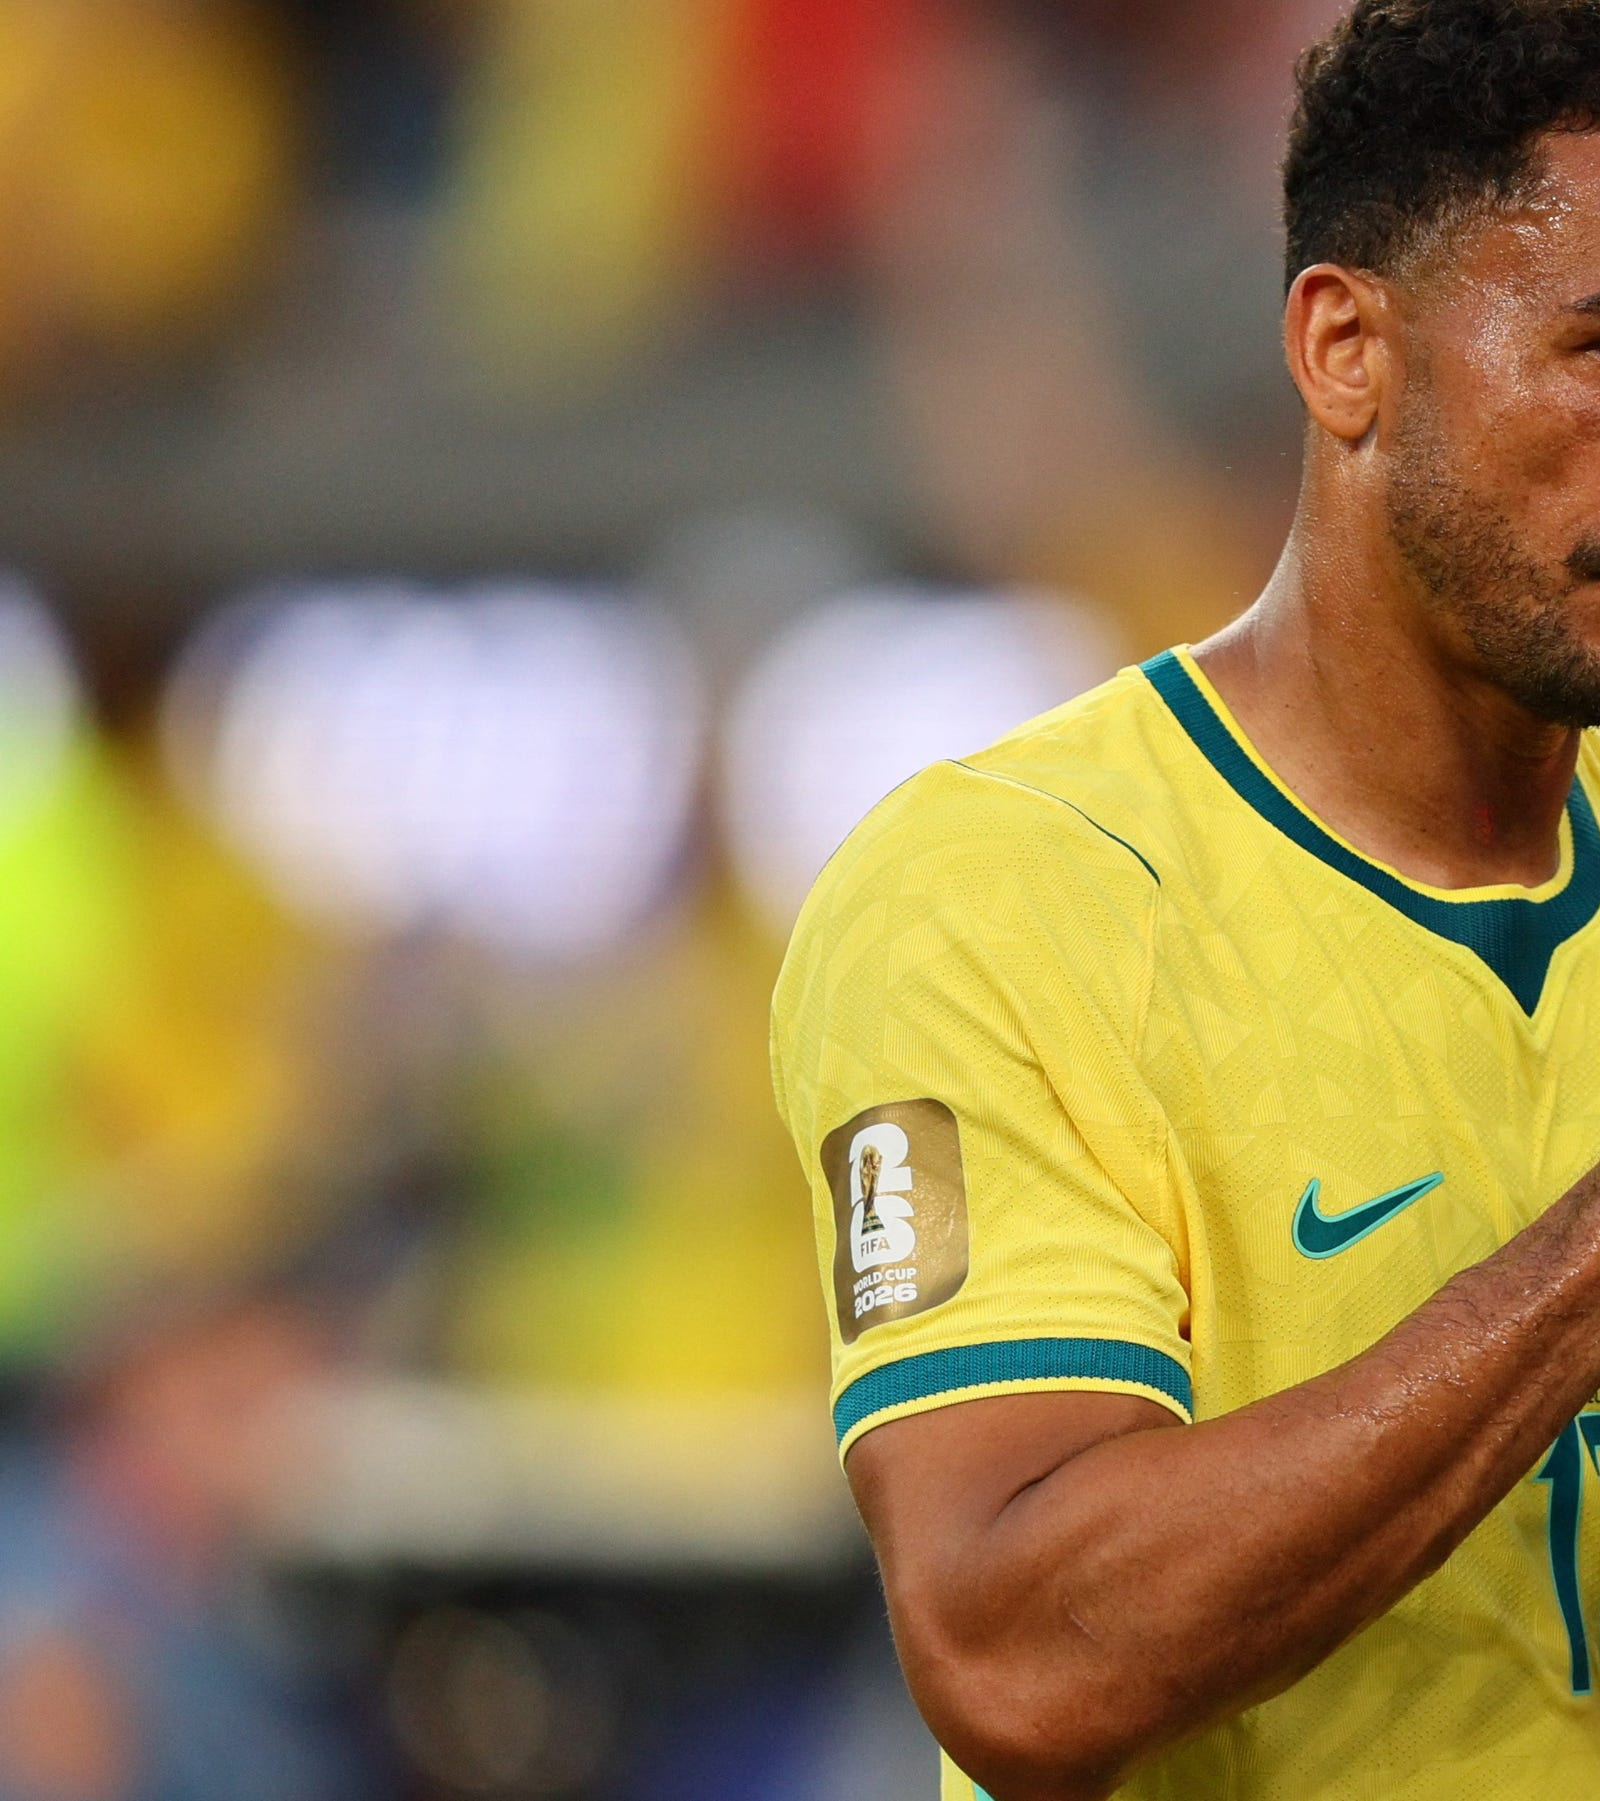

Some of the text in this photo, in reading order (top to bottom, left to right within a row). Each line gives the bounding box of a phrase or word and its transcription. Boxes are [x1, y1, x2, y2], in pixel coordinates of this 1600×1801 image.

[861, 1237, 891, 1257] FIFA
[853, 1267, 917, 1296] WORLD CUP
[854, 1282, 918, 1319] 2026
